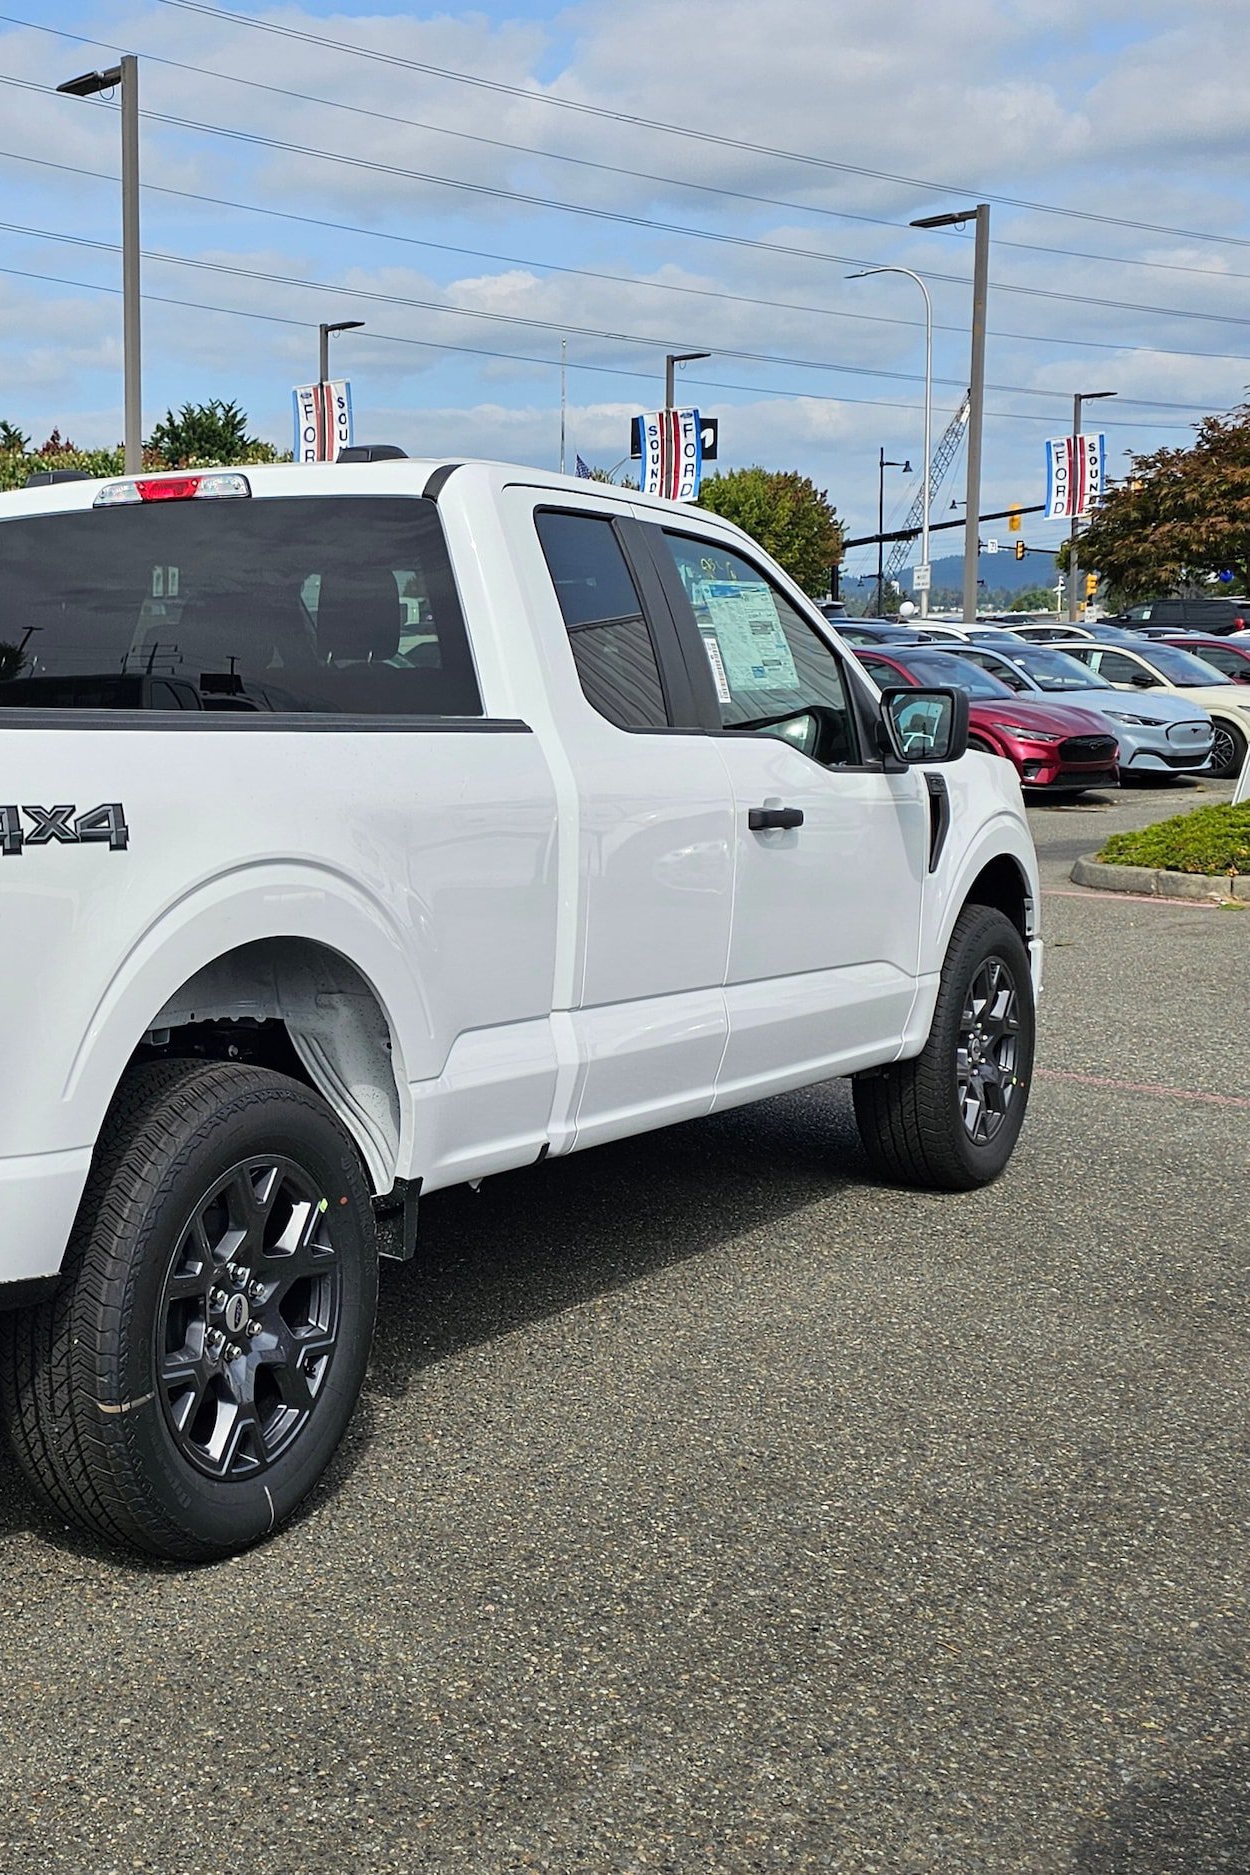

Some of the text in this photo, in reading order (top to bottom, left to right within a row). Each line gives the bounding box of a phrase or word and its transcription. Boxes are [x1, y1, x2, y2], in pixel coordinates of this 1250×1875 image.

[303, 404, 316, 462] FOR
[337, 396, 348, 450] SOU
[648, 425, 659, 493] SOUND
[680, 423, 696, 497] FORD
[1053, 451, 1067, 514] FORD
